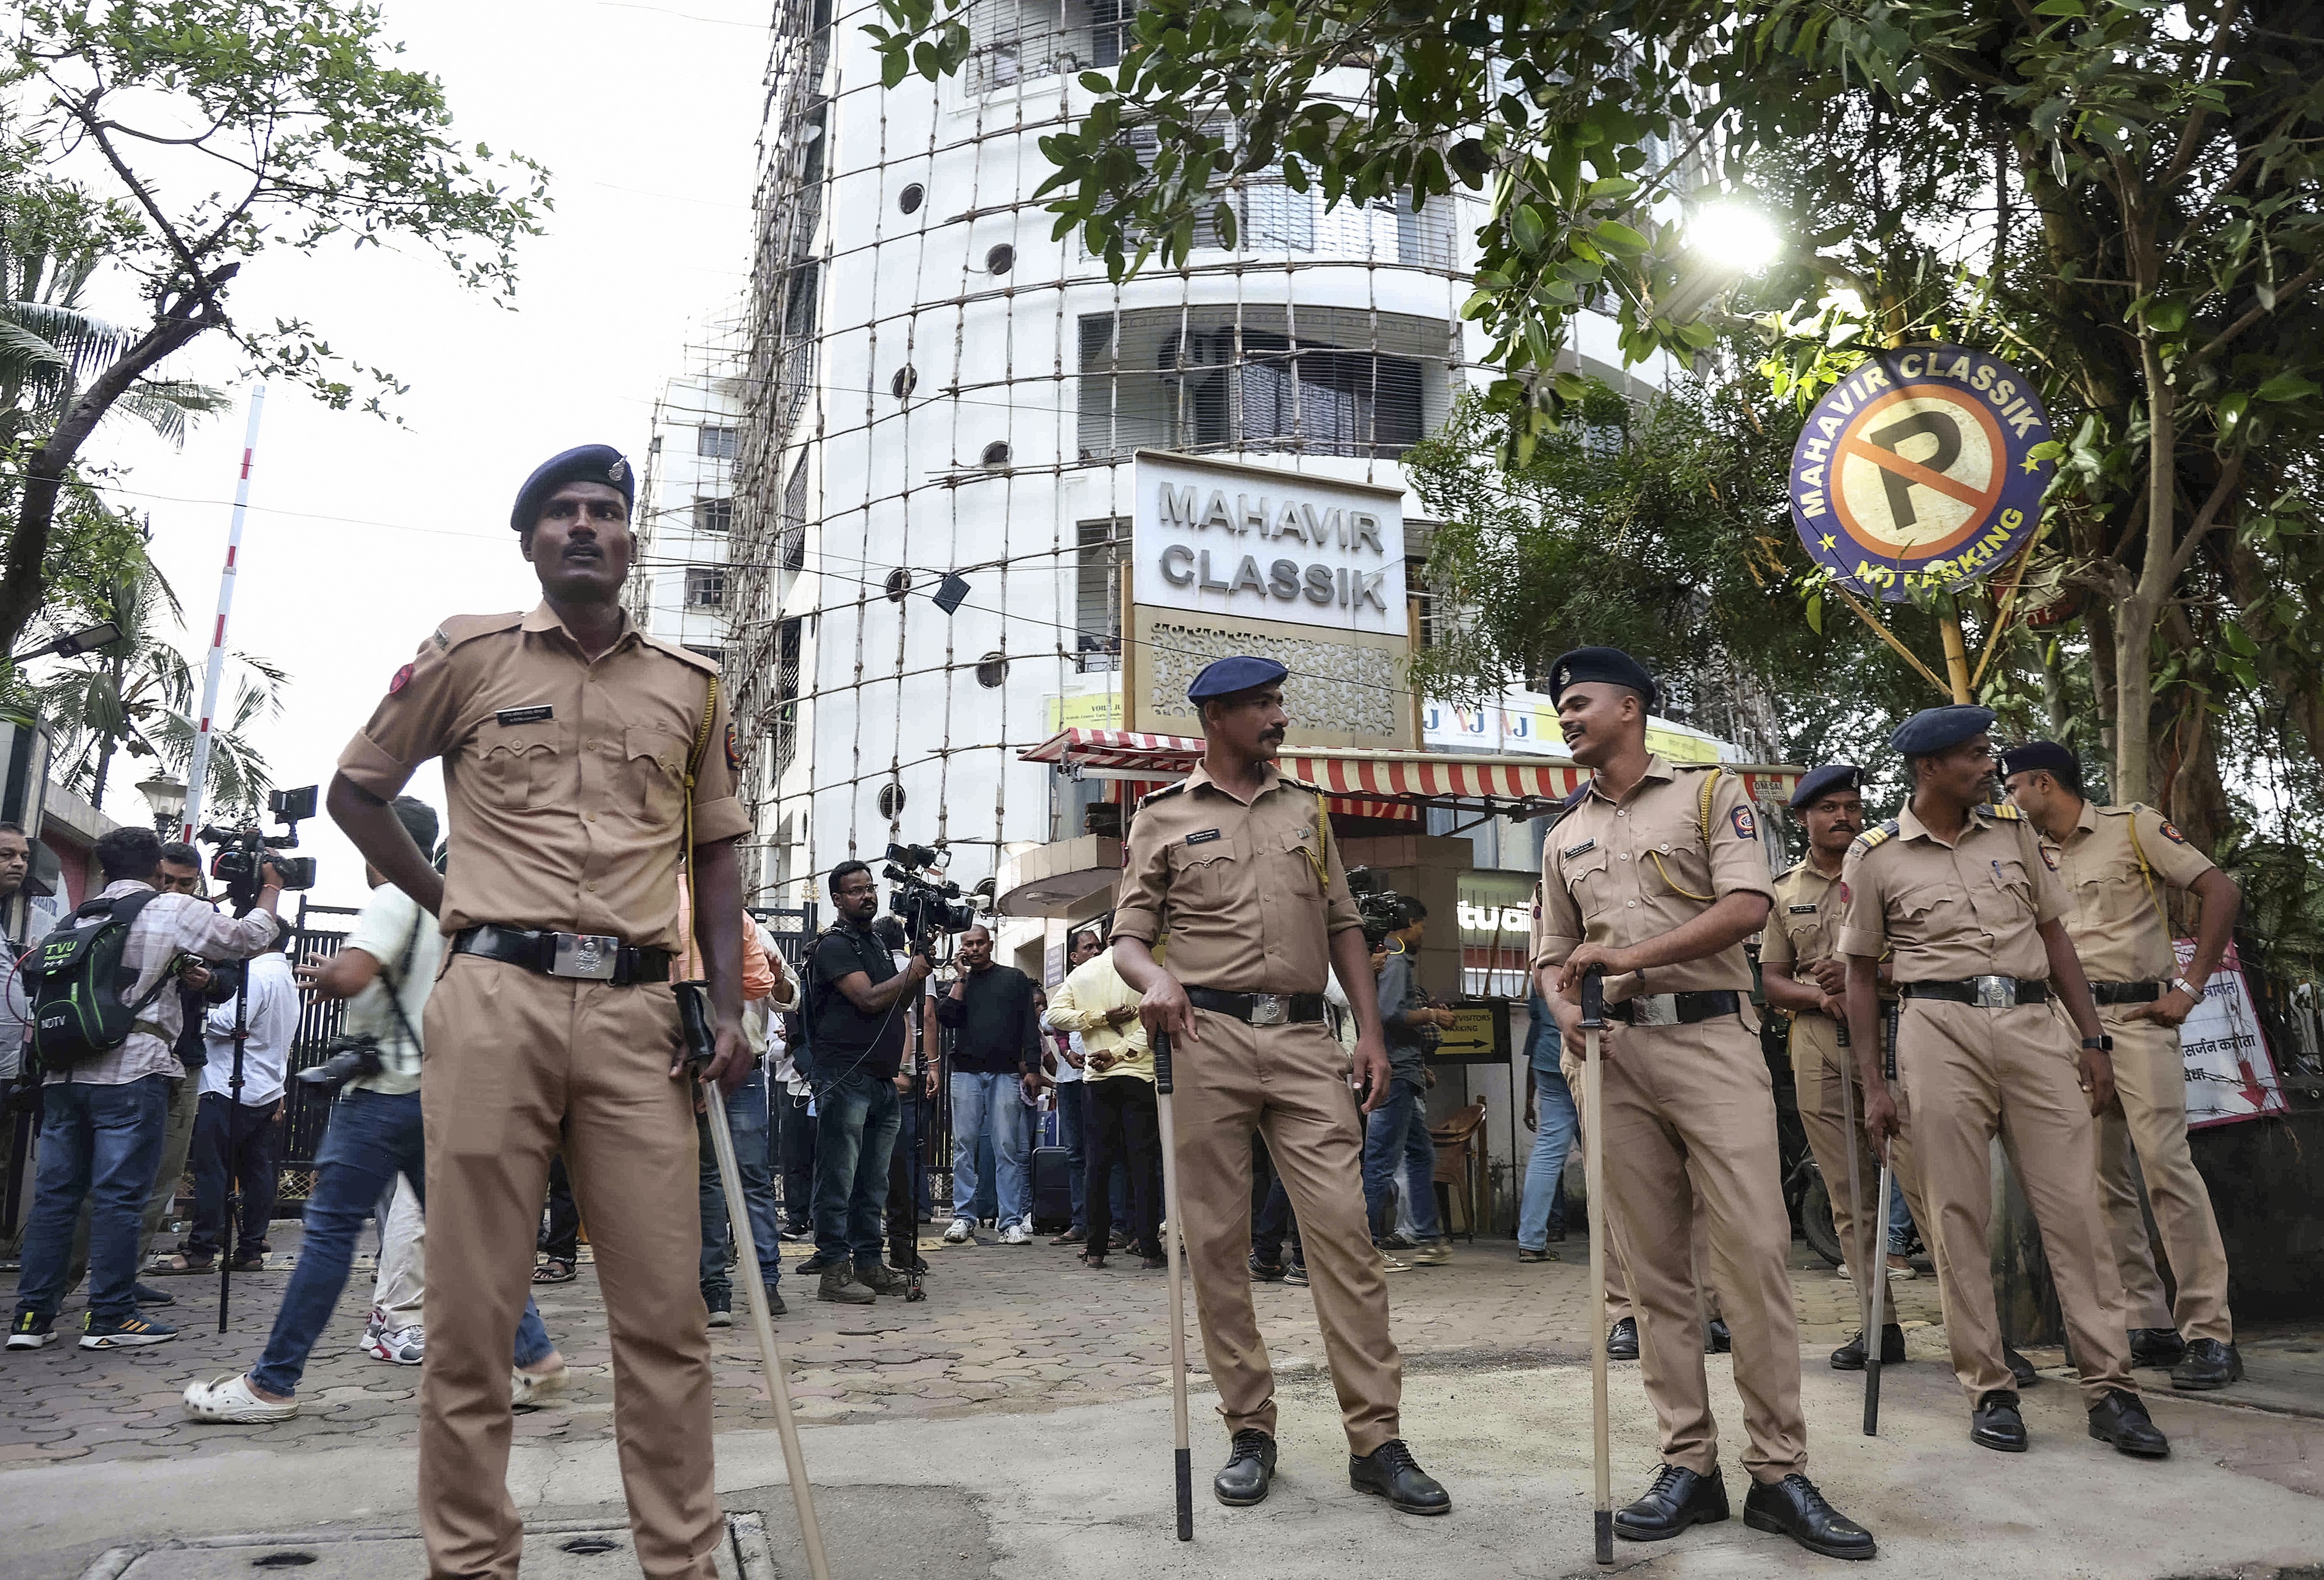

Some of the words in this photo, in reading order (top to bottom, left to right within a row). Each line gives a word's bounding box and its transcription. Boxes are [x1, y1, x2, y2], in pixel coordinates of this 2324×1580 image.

[1800, 365, 1891, 519] MAHAVIR
[1899, 352, 2043, 440] CLASSIK
[1870, 410, 1962, 531] P
[1160, 481, 1384, 553] MAHAVIR
[1159, 544, 1388, 610] CLASSIK
[45, 941, 78, 955] TVU
[2182, 1038, 2217, 1058] सर्जन
